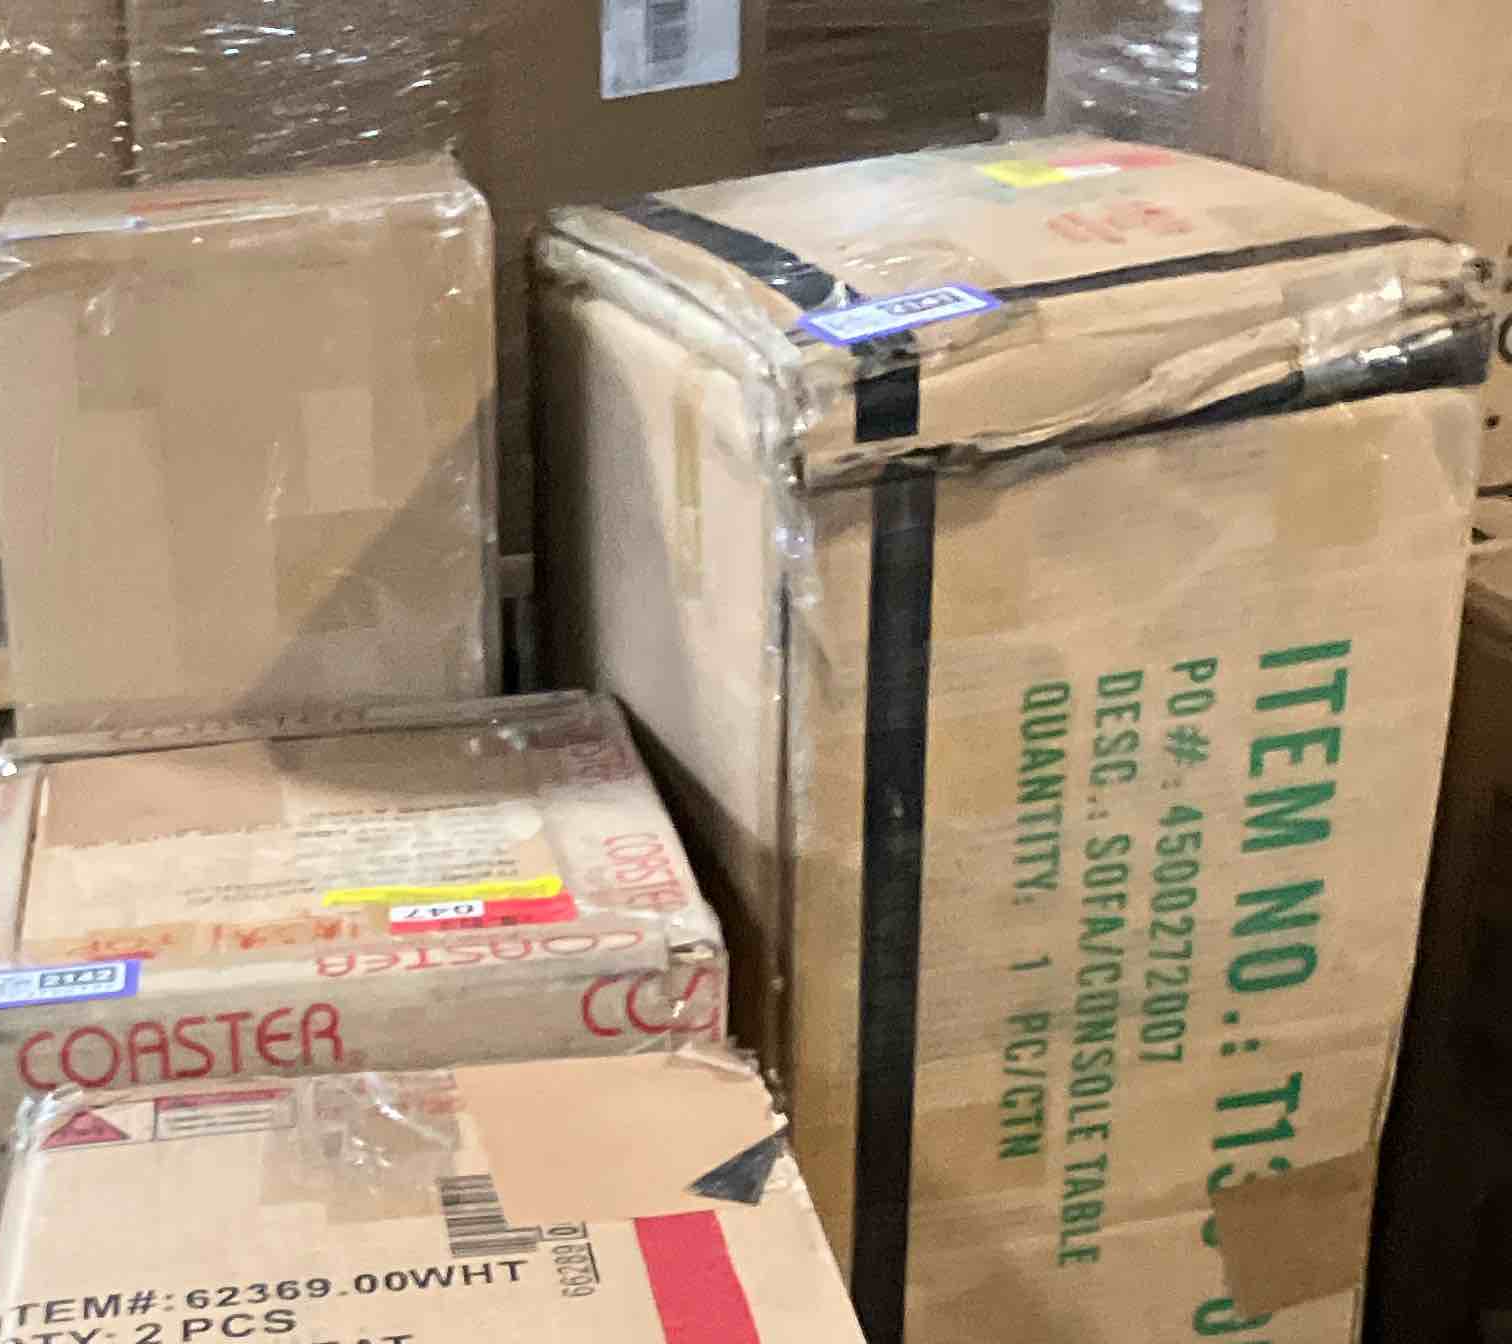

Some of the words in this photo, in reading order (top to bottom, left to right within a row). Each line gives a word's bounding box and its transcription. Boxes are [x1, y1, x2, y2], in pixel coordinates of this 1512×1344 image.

[1241, 640, 1352, 854] ITEM
[316, 930, 644, 977] COASTER
[1009, 952, 1051, 971] 1
[1066, 833, 1131, 1144] SOFA/CONSOLE
[1139, 804, 1204, 1063] 4500272007
[17, 1003, 344, 1090] COASTER
[997, 1012, 1051, 1160] PC/CTN
[1057, 1153, 1108, 1267] TABLE
[182, 1308, 296, 1341] PCS
